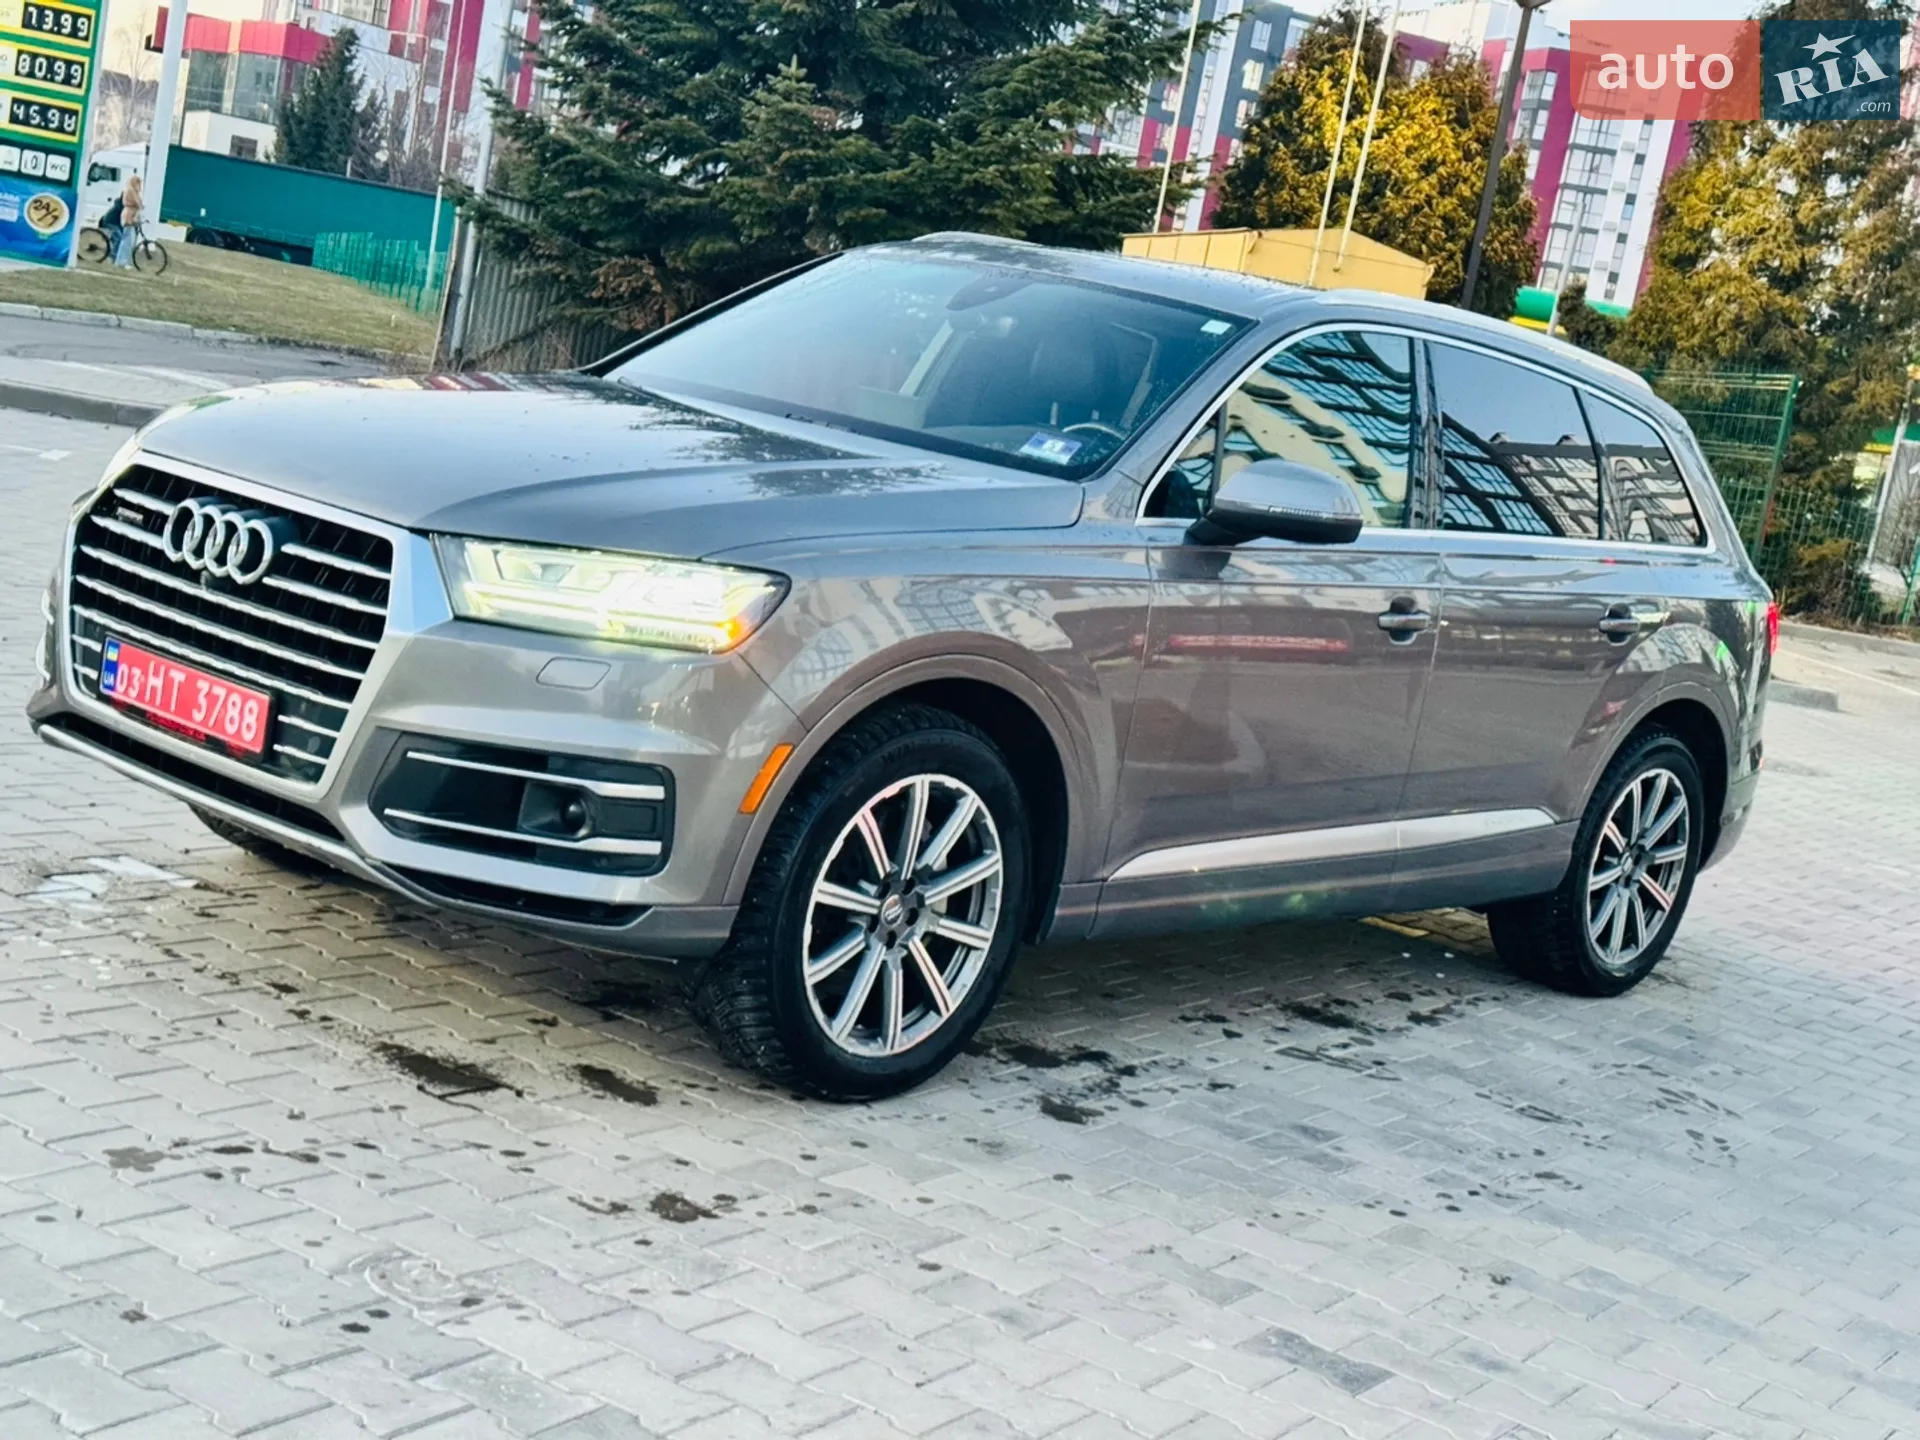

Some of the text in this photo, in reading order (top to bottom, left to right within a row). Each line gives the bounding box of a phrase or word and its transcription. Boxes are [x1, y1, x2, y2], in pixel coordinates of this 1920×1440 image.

[18, 53, 82, 86] 80.99
[50, 161, 68, 174] WC
[103, 671, 115, 687] UA
[145, 660, 186, 713] HT
[191, 679, 260, 742] 3788
